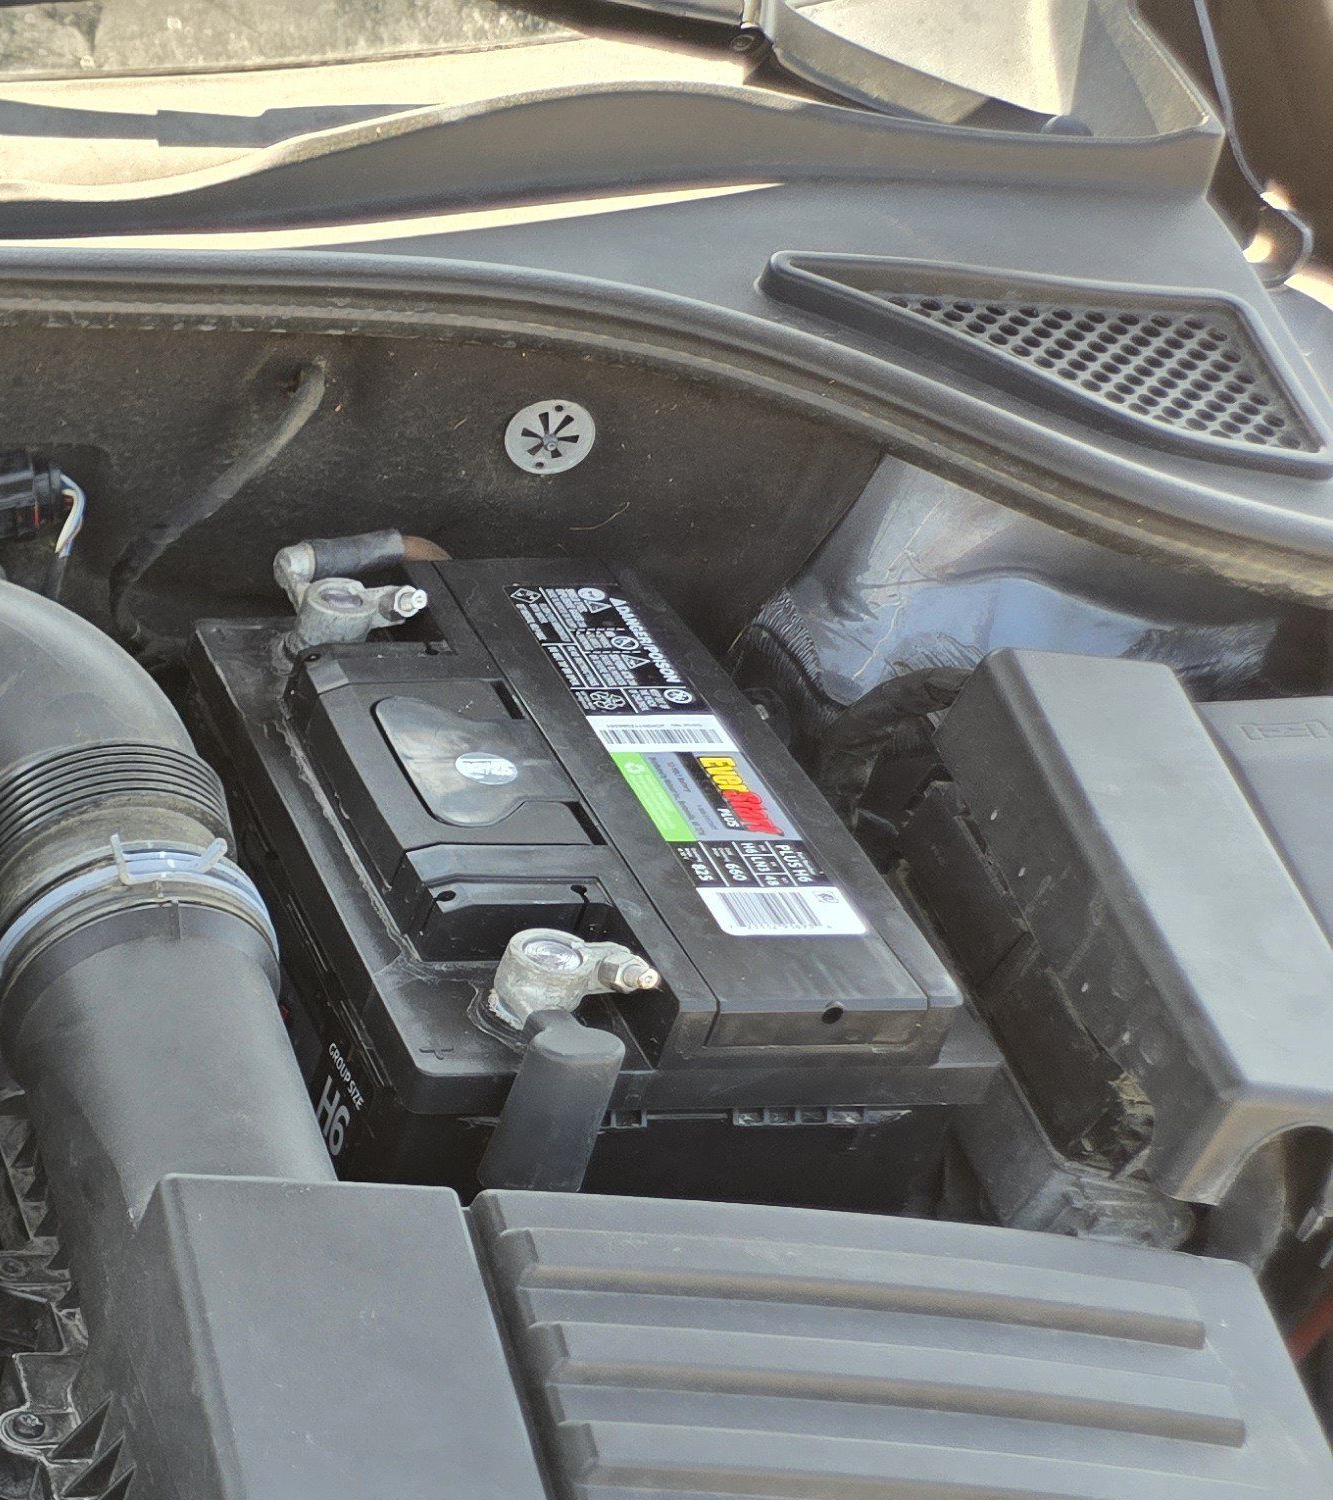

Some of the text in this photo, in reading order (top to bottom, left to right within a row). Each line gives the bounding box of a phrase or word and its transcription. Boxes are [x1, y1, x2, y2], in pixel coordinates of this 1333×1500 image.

[616, 605, 681, 683] DANGER/POISON
[698, 756, 784, 836] EverStart
[717, 807, 740, 829] PLUS
[691, 863, 715, 881] 825
[724, 863, 748, 882] 660
[775, 844, 804, 868] PLUS
[328, 1042, 365, 1111] GROUP SIZE
[316, 1074, 351, 1156] H6
